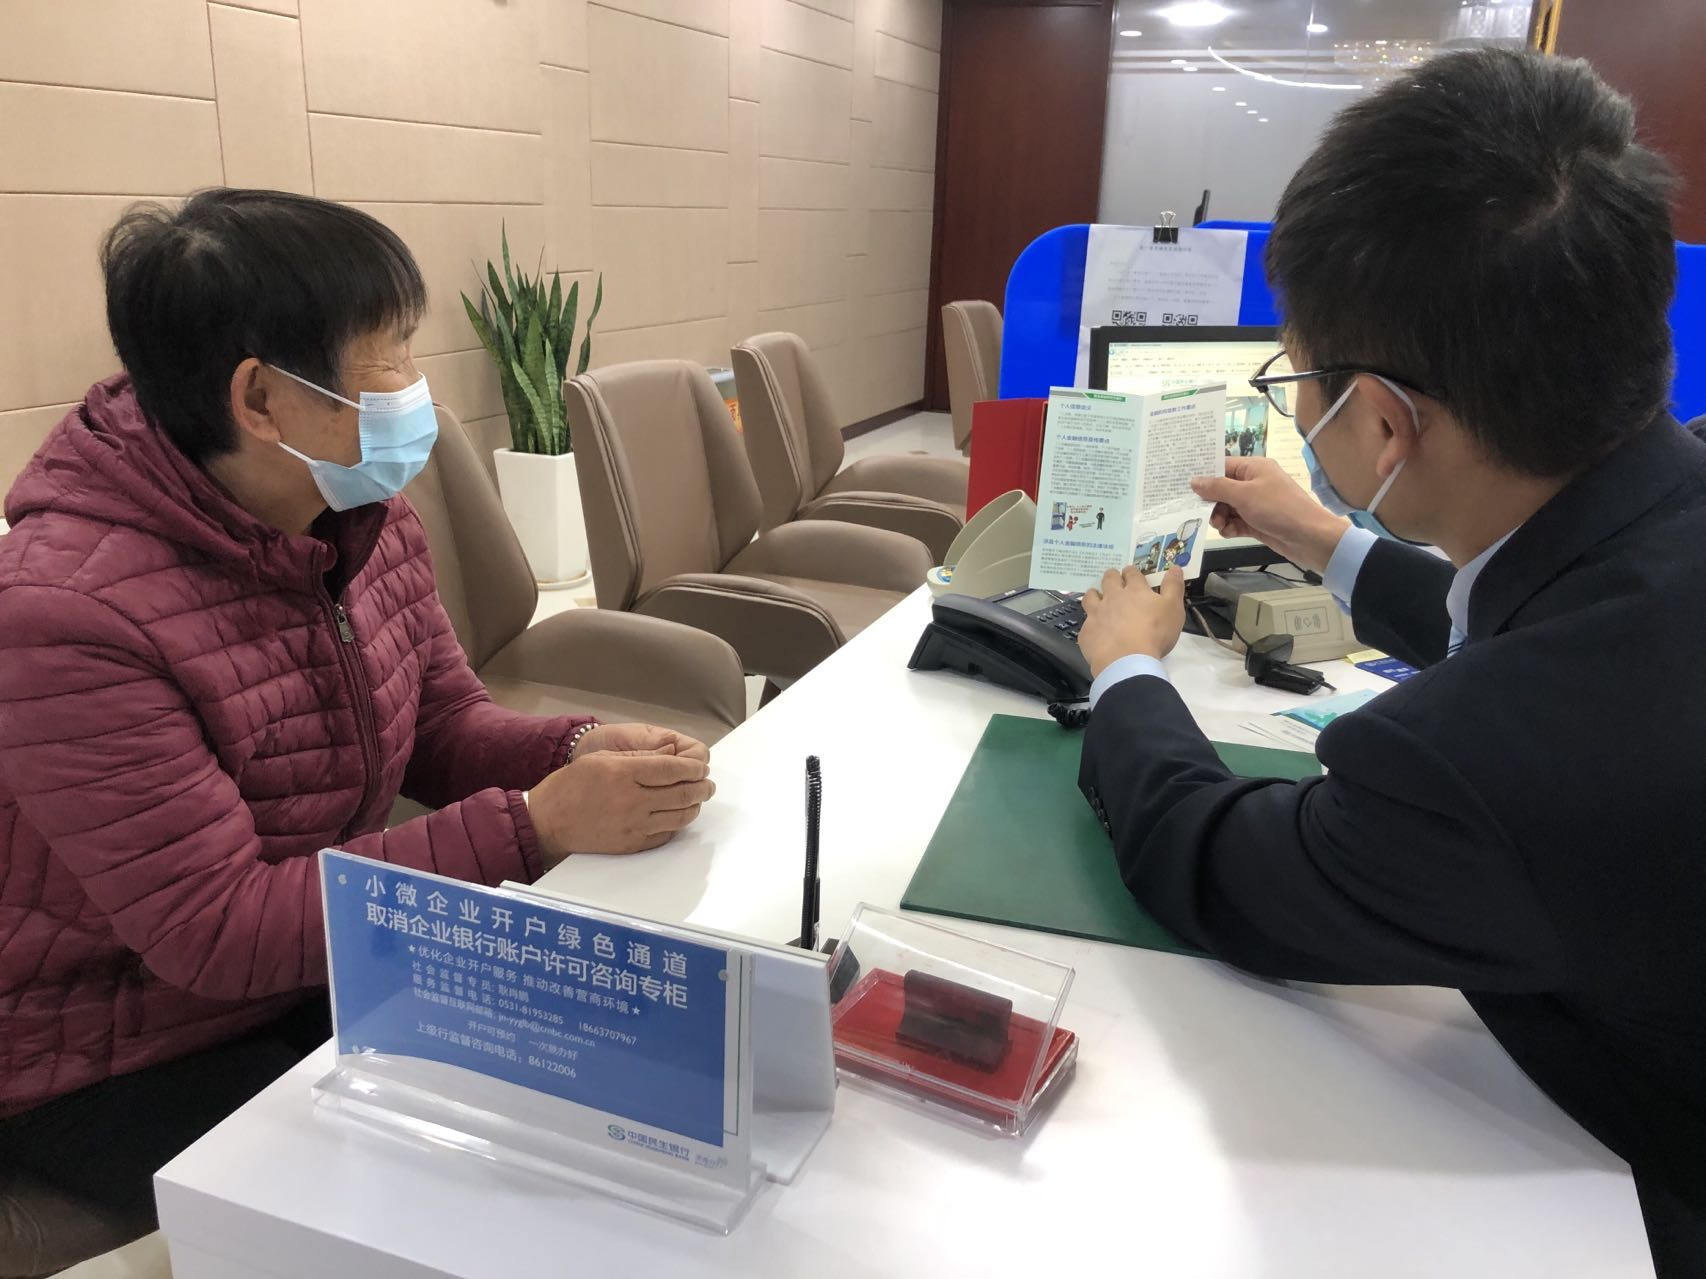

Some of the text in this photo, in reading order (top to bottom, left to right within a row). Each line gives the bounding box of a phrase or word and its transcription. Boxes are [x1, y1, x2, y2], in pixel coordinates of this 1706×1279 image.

[365, 874, 688, 979] 小微企业开户绿色通道
[366, 901, 688, 1010] 取消企业银行账户许可咨询专柜
[522, 973, 630, 1015] 推动改善营商环境
[578, 1021, 637, 1046] 18663707967
[528, 1055, 577, 1079] 86122006
[627, 1130, 690, 1157] 中国民生银行
